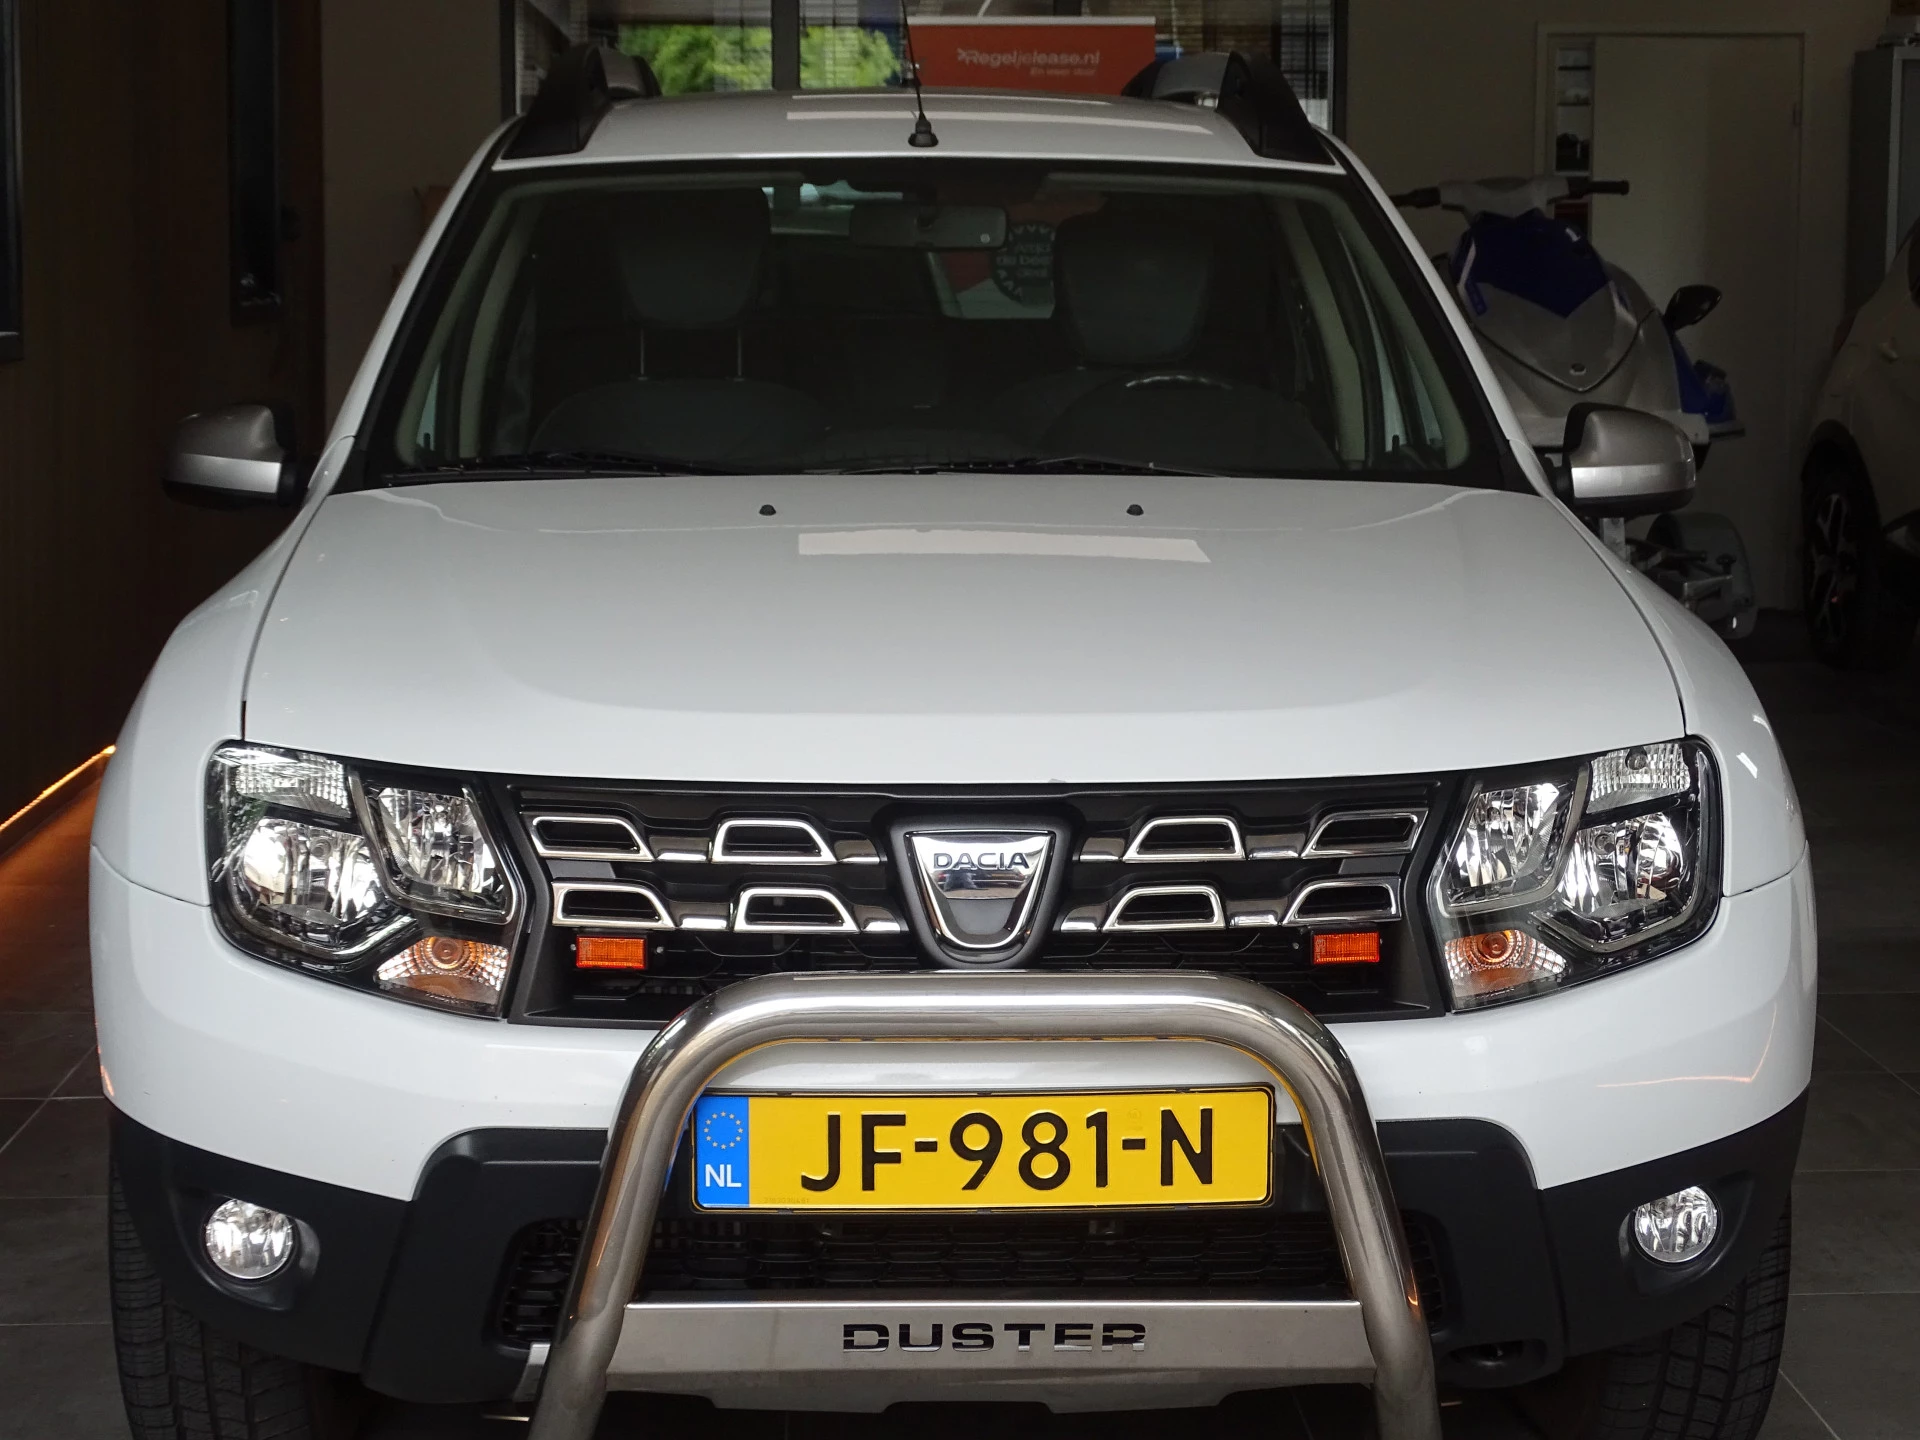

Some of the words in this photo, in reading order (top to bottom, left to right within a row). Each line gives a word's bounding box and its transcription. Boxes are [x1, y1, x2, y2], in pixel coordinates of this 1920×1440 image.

[933, 853, 1030, 870] DACIA
[705, 1164, 742, 1188] NL
[801, 1105, 1213, 1192] JF-981-N
[843, 1322, 1146, 1352] DUSTER
